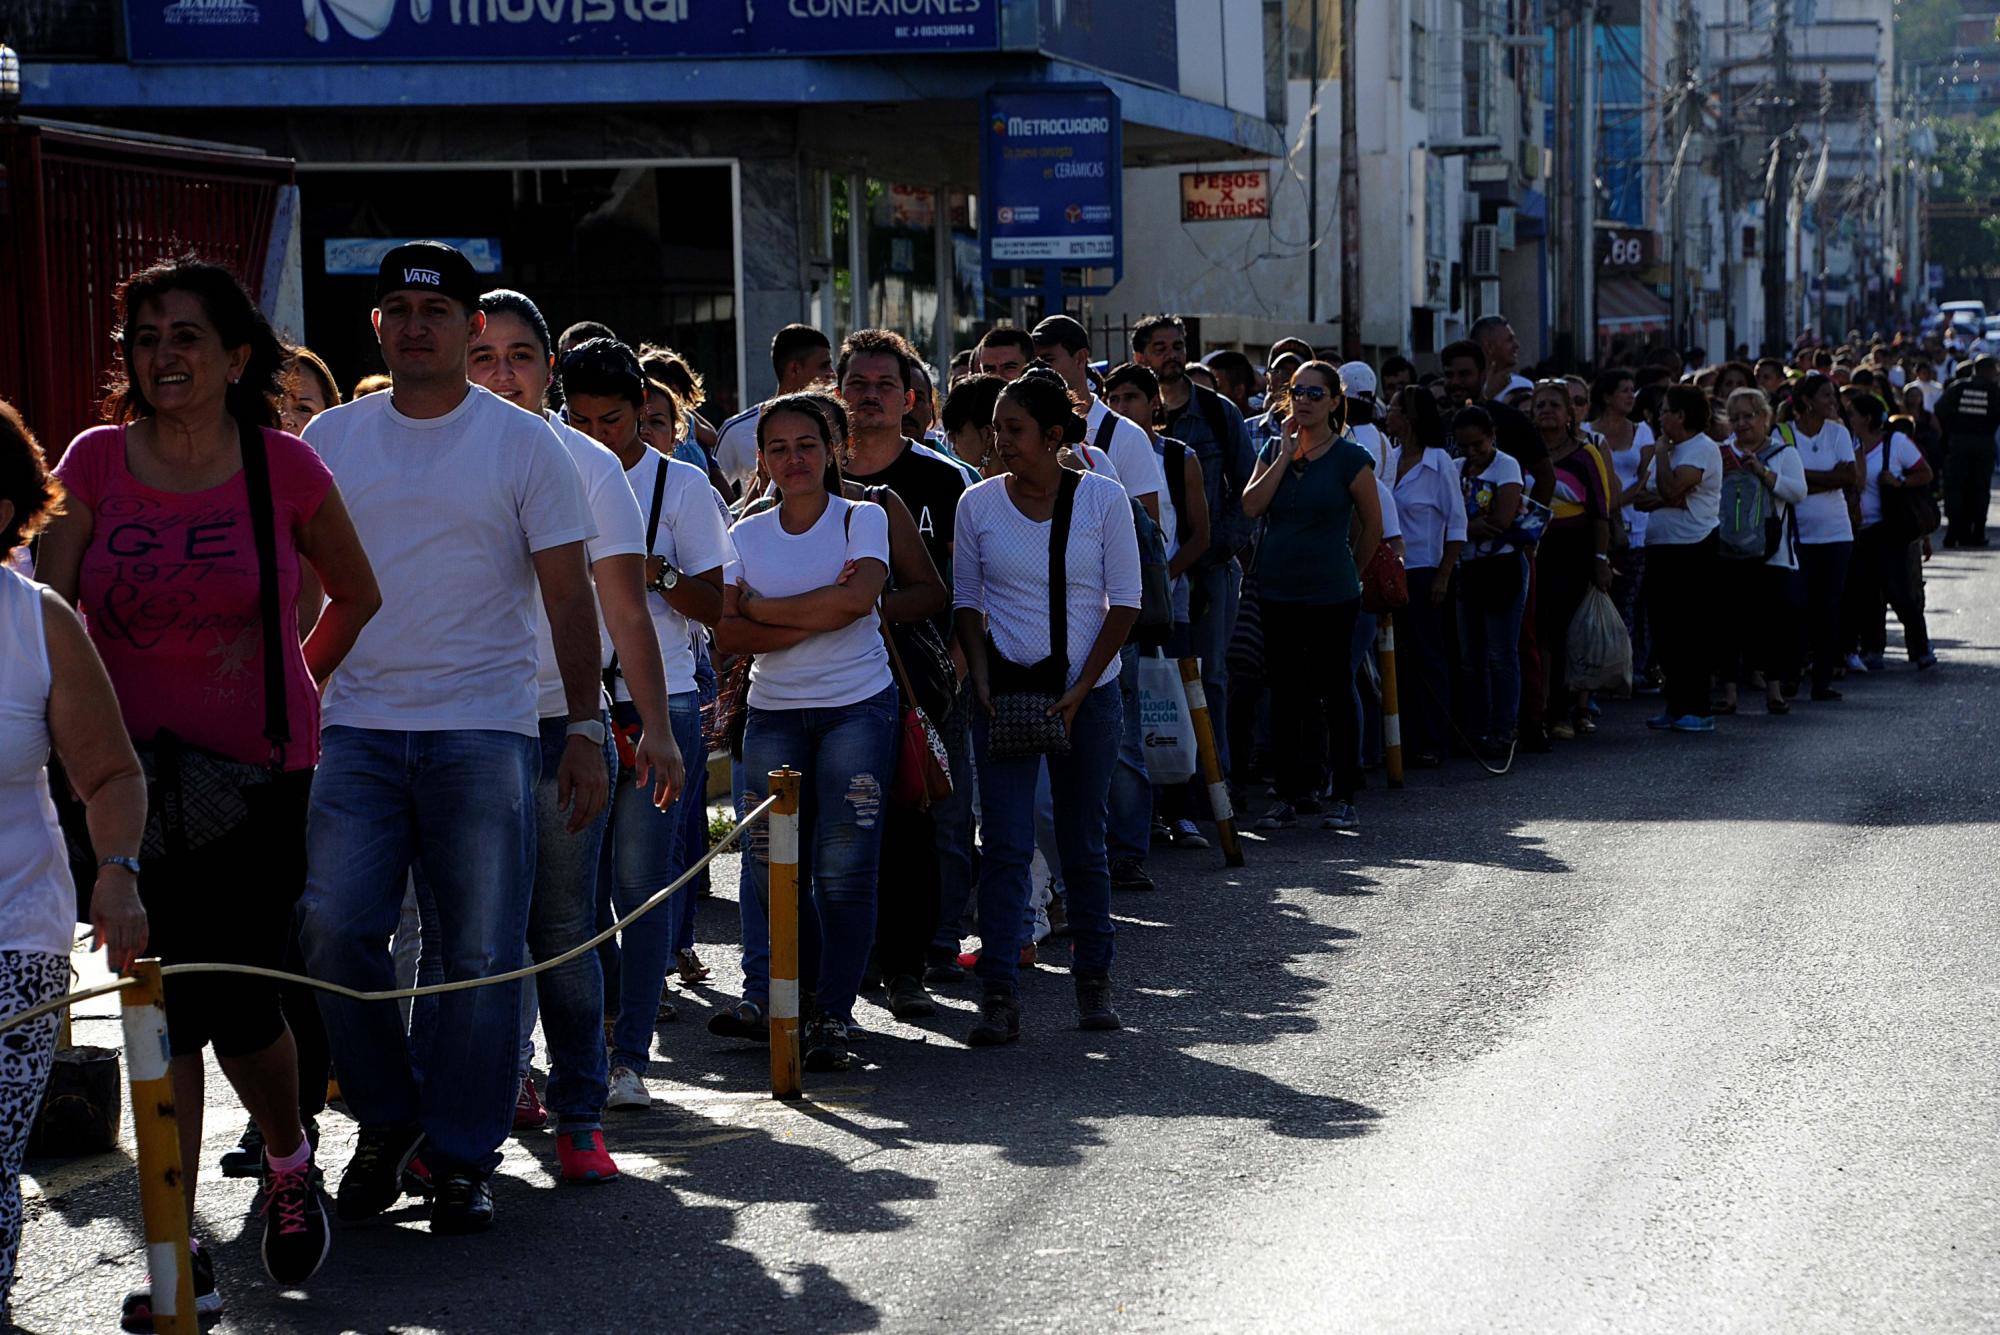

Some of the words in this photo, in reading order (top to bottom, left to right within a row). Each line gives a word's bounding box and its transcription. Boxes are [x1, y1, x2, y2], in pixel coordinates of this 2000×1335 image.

[788, 0, 981, 19] CONEXIONES
[1008, 116, 1109, 137] METROCUADRO
[1054, 160, 1104, 179] CERÁMICAS
[1194, 174, 1260, 189] PESOS
[403, 267, 441, 286] VANS
[918, 505, 935, 538] A
[111, 561, 216, 583] 1977
